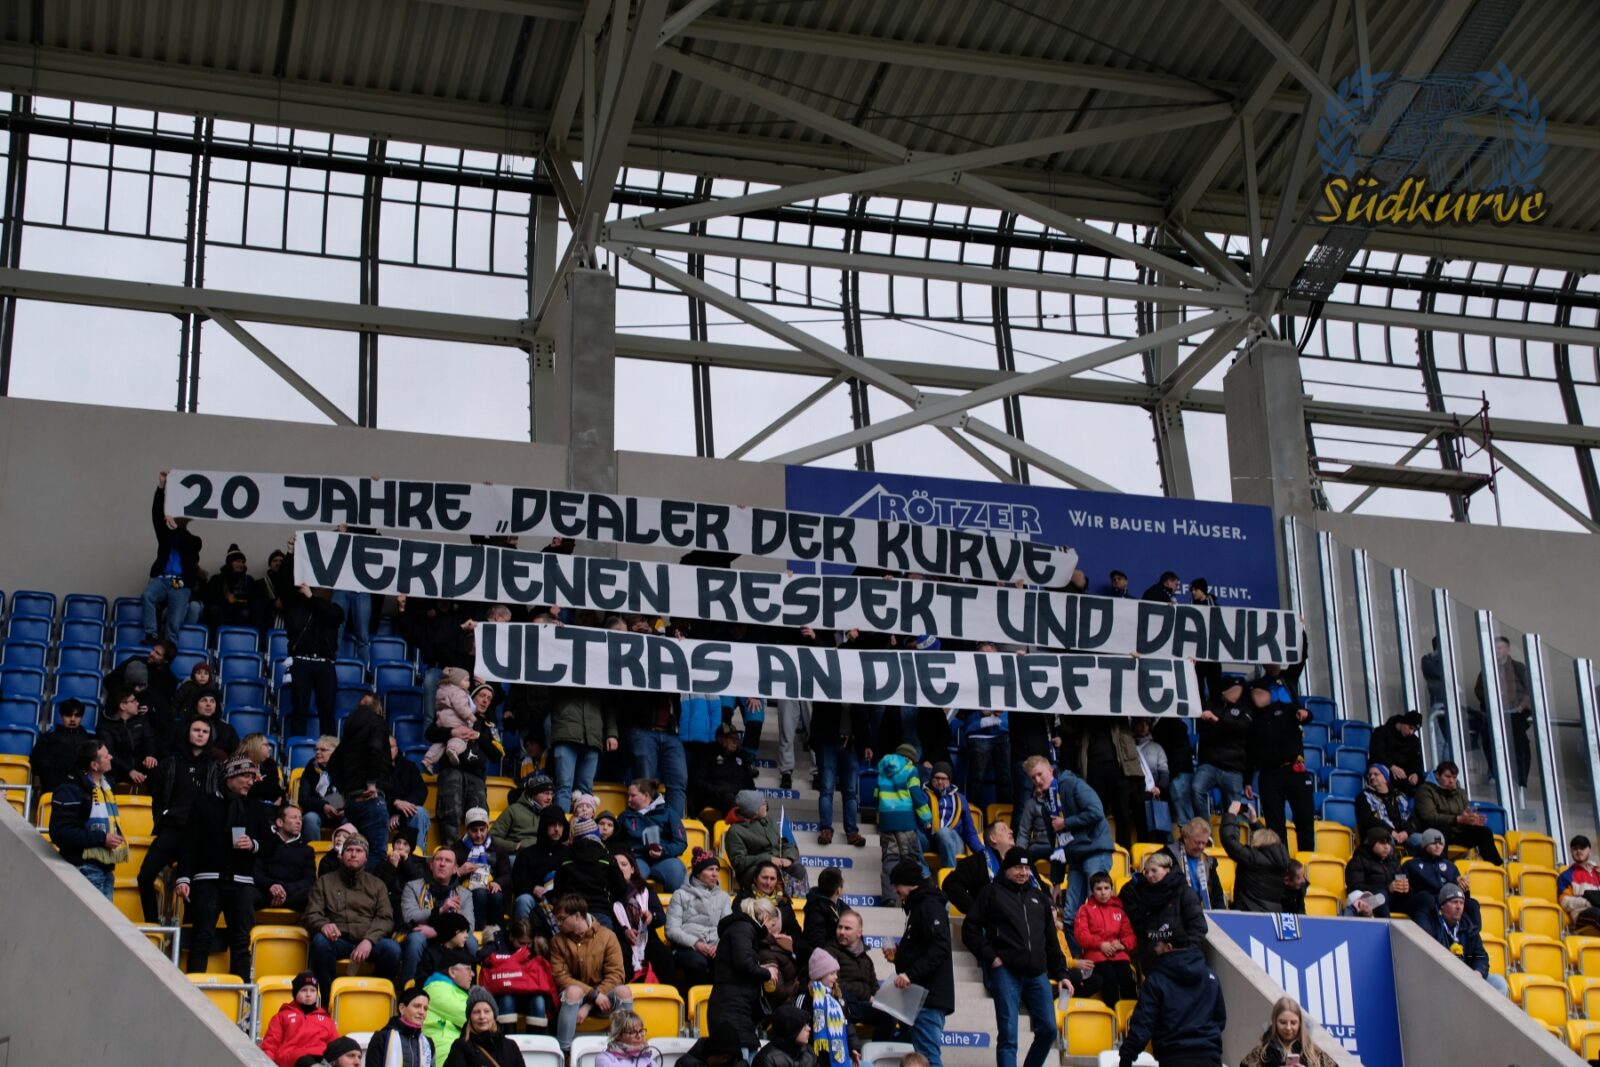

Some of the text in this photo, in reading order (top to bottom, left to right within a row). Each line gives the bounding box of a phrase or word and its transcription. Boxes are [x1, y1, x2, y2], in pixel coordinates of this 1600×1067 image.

[180, 474, 259, 520] 20
[283, 476, 472, 531] JAHRE
[751, 508, 857, 563] DER
[879, 490, 1042, 535] RÖTZER
[304, 531, 1299, 662] VERDIENEN RESPEKT UND DANK!
[481, 624, 1189, 717] ULTRAS AN DIE HEFTE!
[782, 790, 793, 799] 13
[807, 823, 818, 832] 12
[801, 857, 845, 868] Reihe 11
[861, 896, 875, 906] 10
[940, 1032, 981, 1045] Reihe 7
